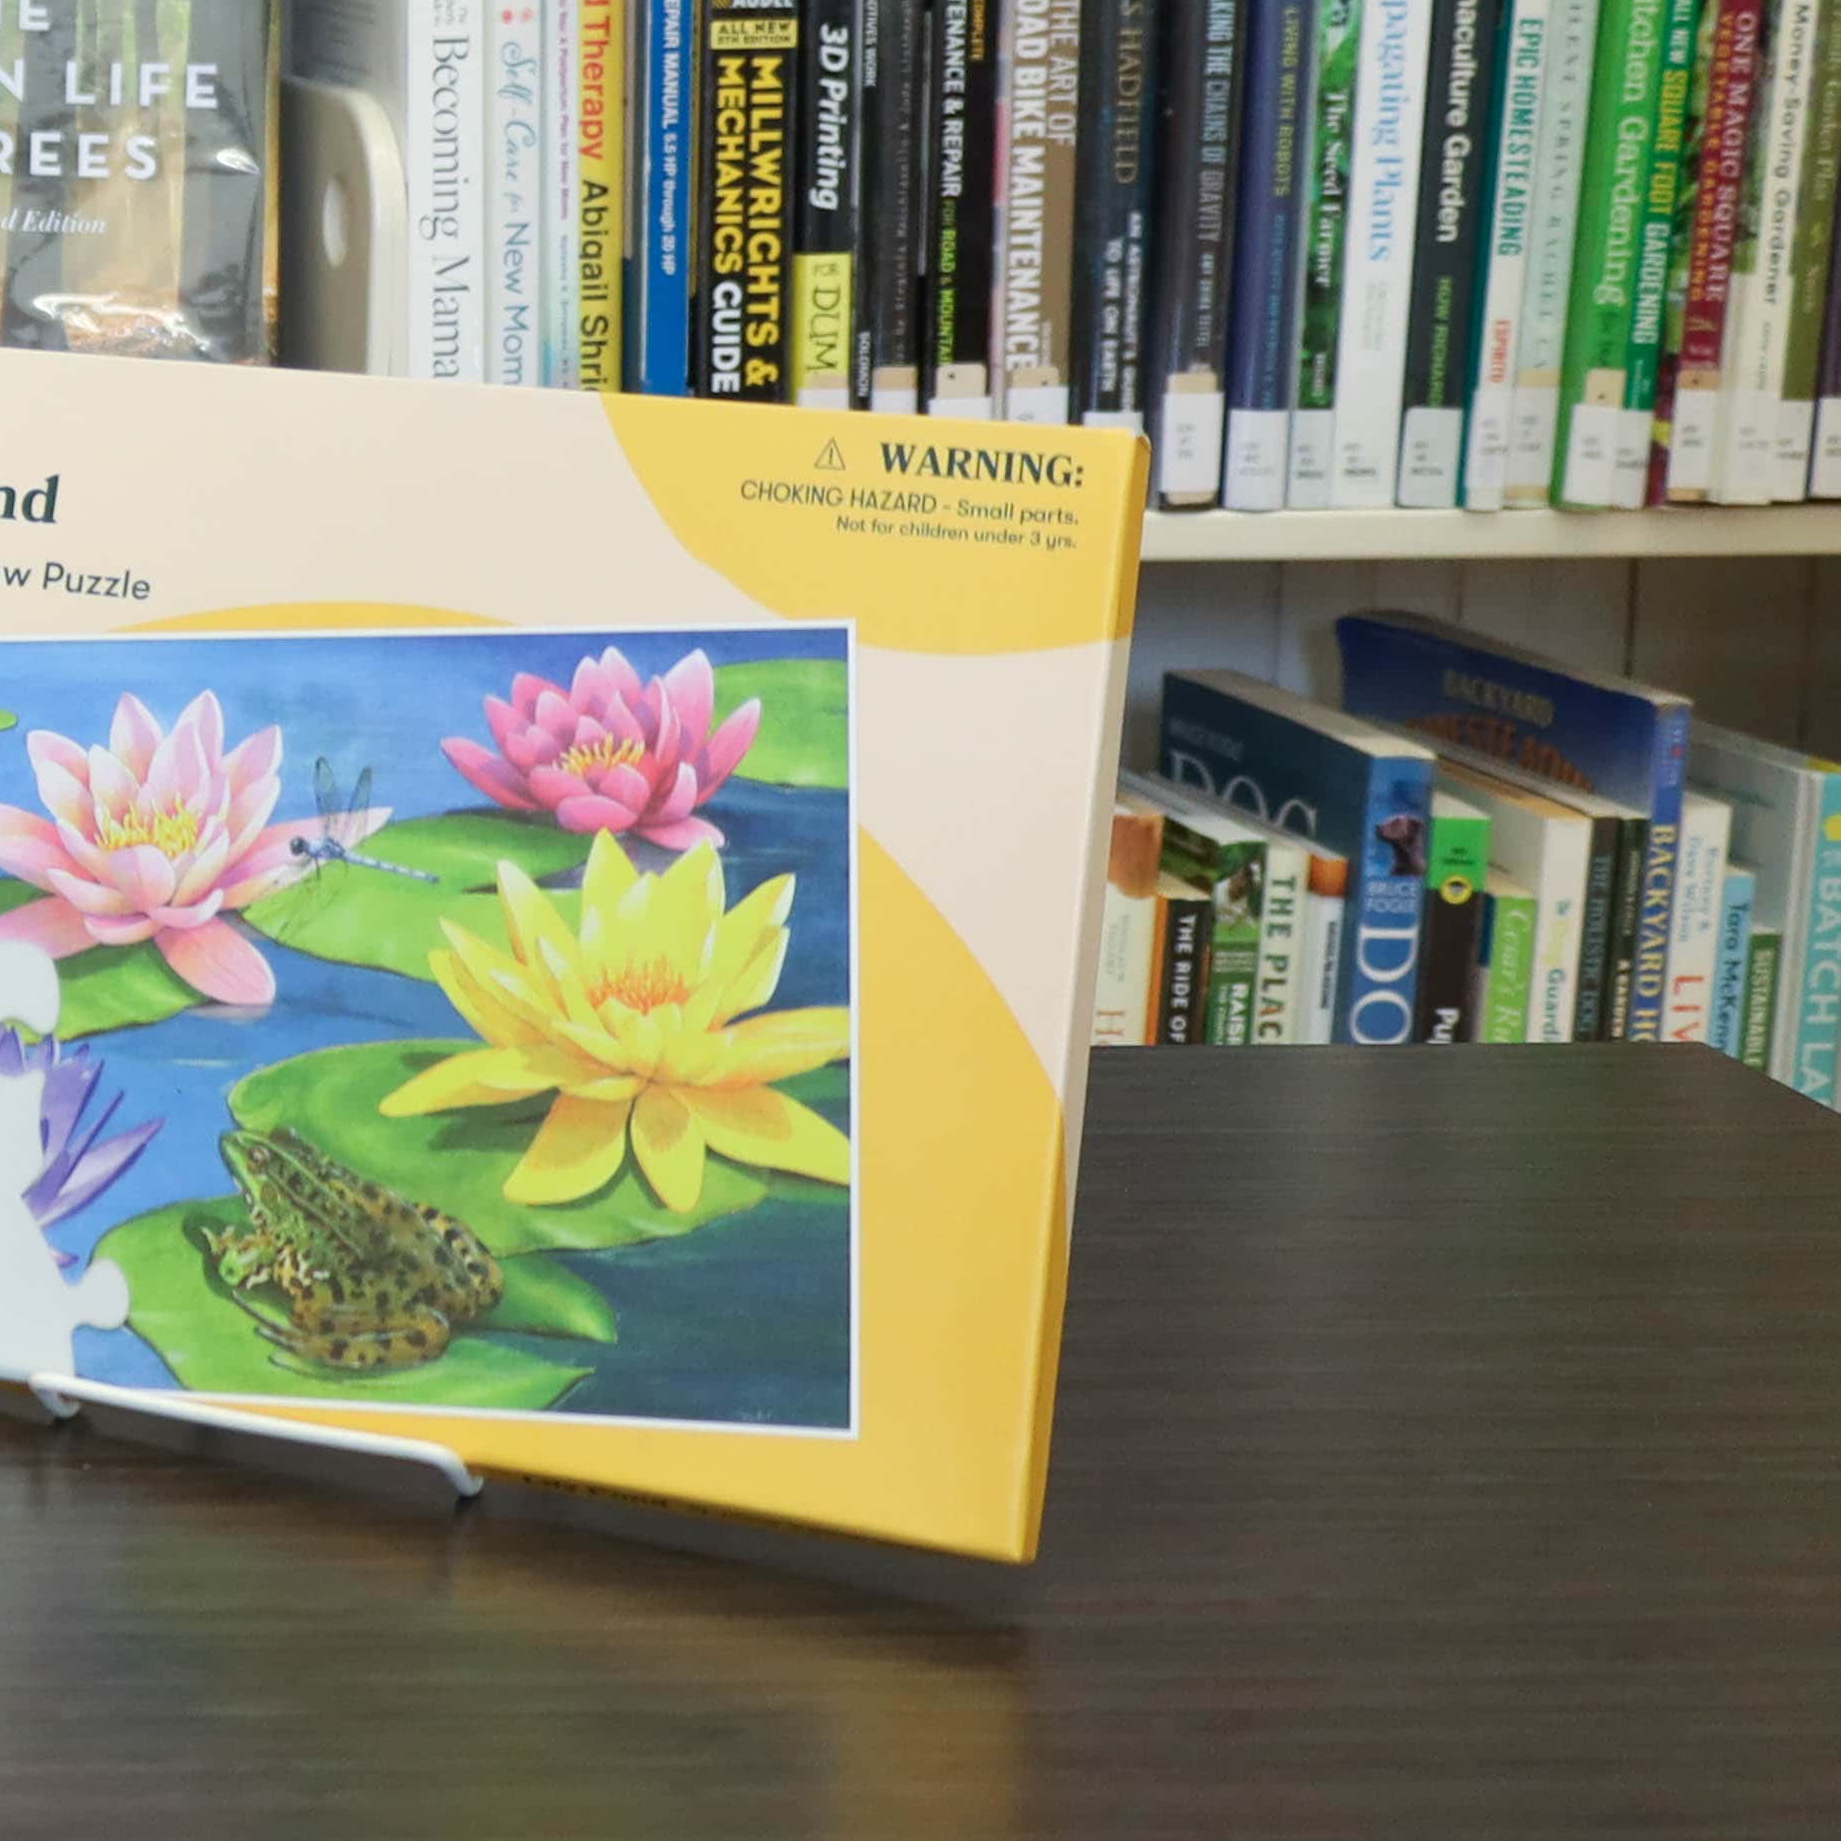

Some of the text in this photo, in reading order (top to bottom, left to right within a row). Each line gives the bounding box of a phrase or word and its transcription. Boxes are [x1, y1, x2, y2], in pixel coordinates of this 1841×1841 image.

[64, 63, 218, 108] LIFE
[577, 15, 609, 161] Therapy
[809, 23, 848, 210] 3D Printing
[1436, 134, 1473, 243] Garden
[21, 208, 107, 234] Edition
[711, 57, 741, 392] MECHANICS GUIDE
[746, 58, 782, 387] MILLWRIGHTS &
[880, 442, 1084, 489] WARNING:
[740, 480, 1078, 526] CHOKING HAZARD Small parts.
[836, 515, 1077, 549] Not for children under 3 yrs.
[43, 562, 151, 600] Puzzle
